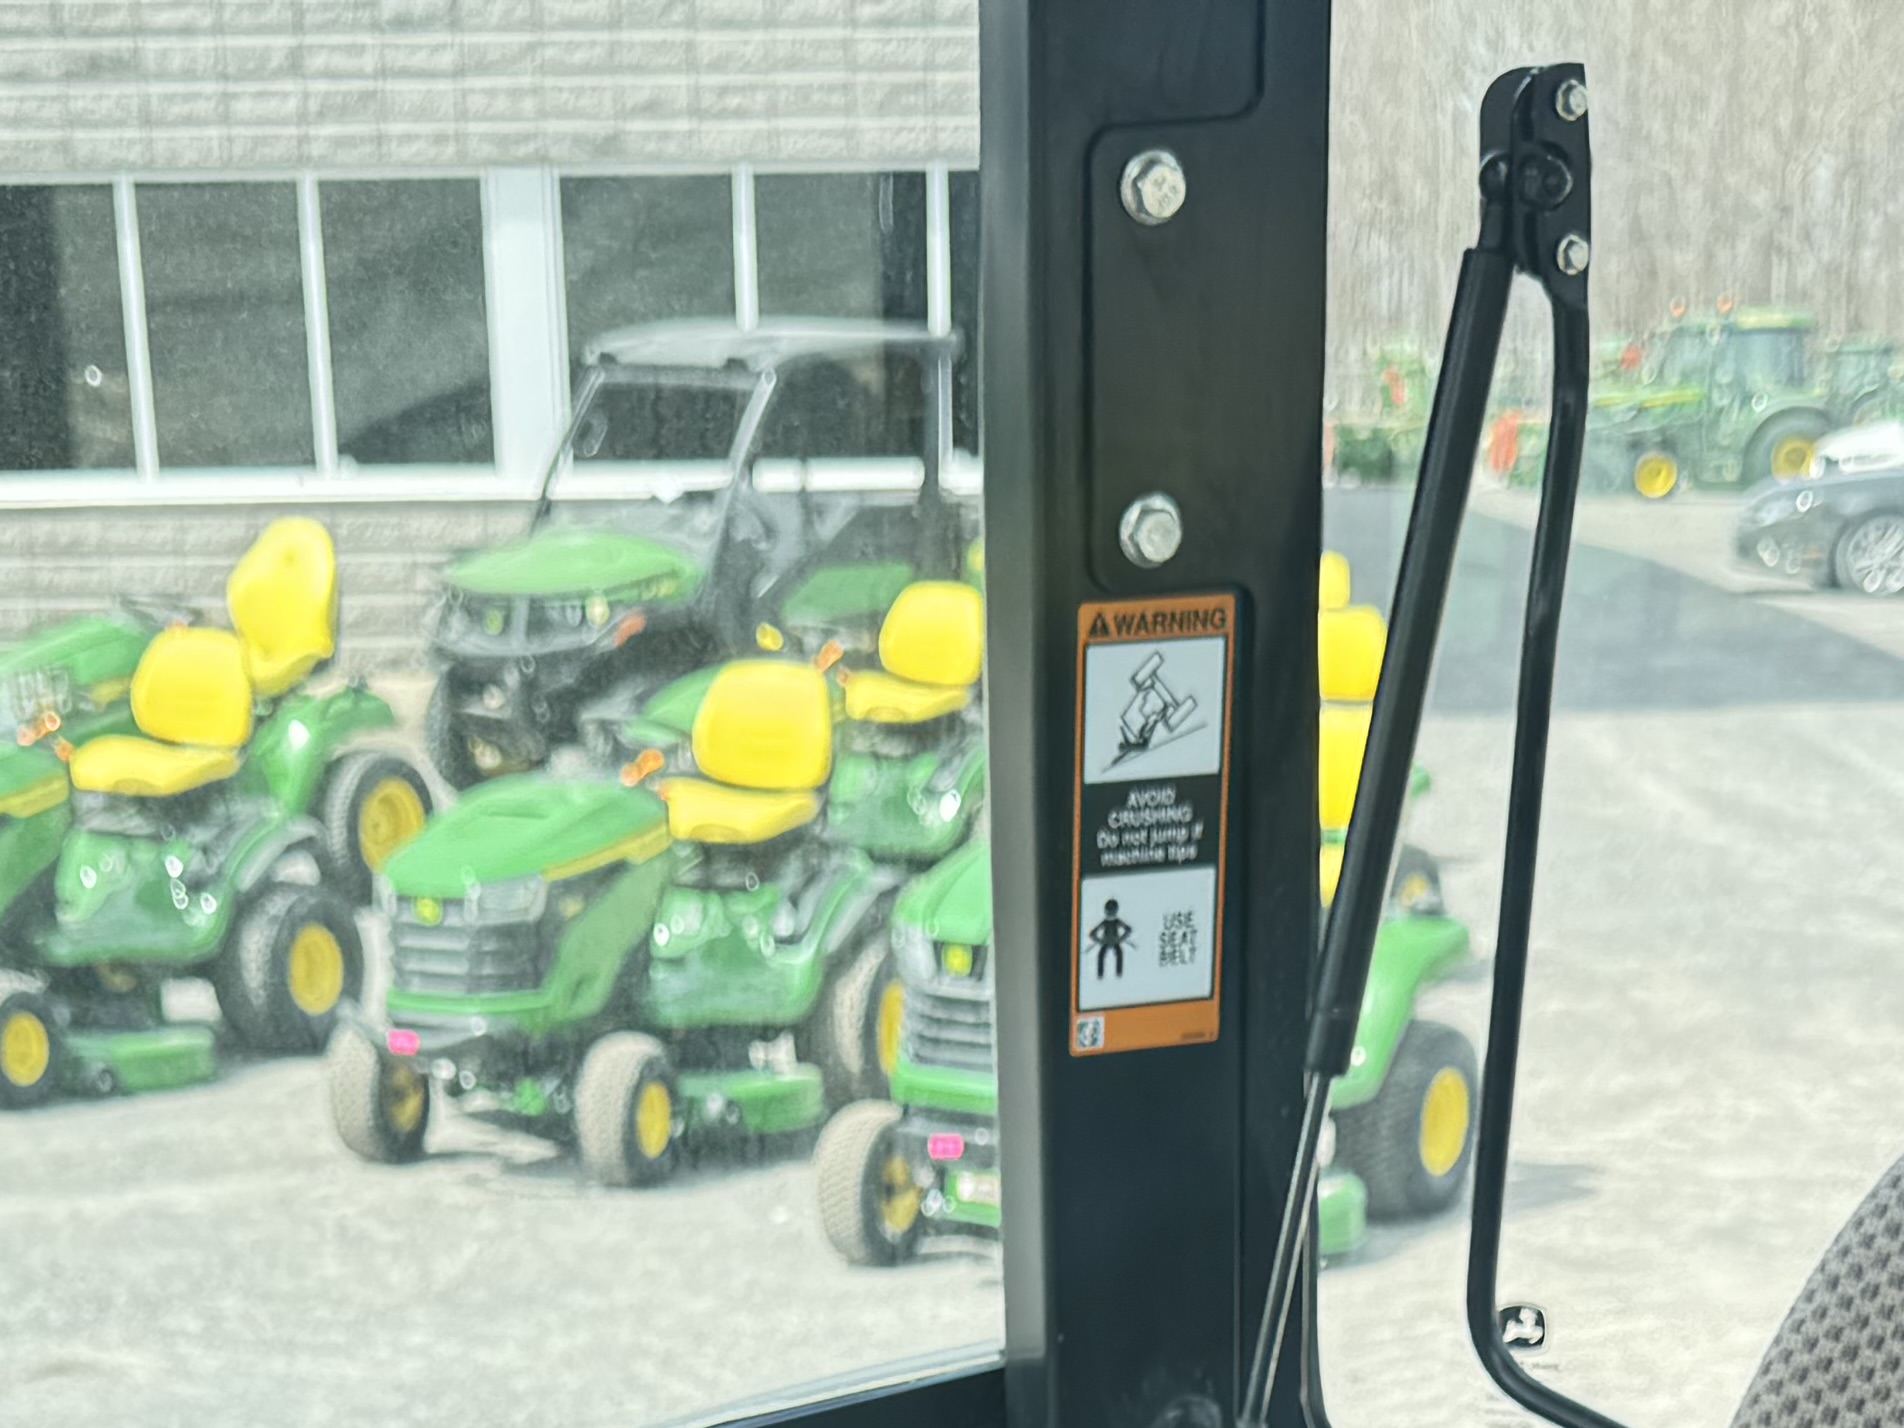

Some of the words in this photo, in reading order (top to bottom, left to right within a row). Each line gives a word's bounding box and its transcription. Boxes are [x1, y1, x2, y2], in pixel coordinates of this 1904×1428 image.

[1114, 608, 1227, 636] WARNING
[1127, 785, 1176, 808] AVOID
[1108, 803, 1193, 829] CRUSHING
[1097, 829, 1119, 849] Do
[1163, 910, 1195, 929] USE
[1159, 929, 1197, 946] SEAT
[1159, 947, 1197, 967] BELT
